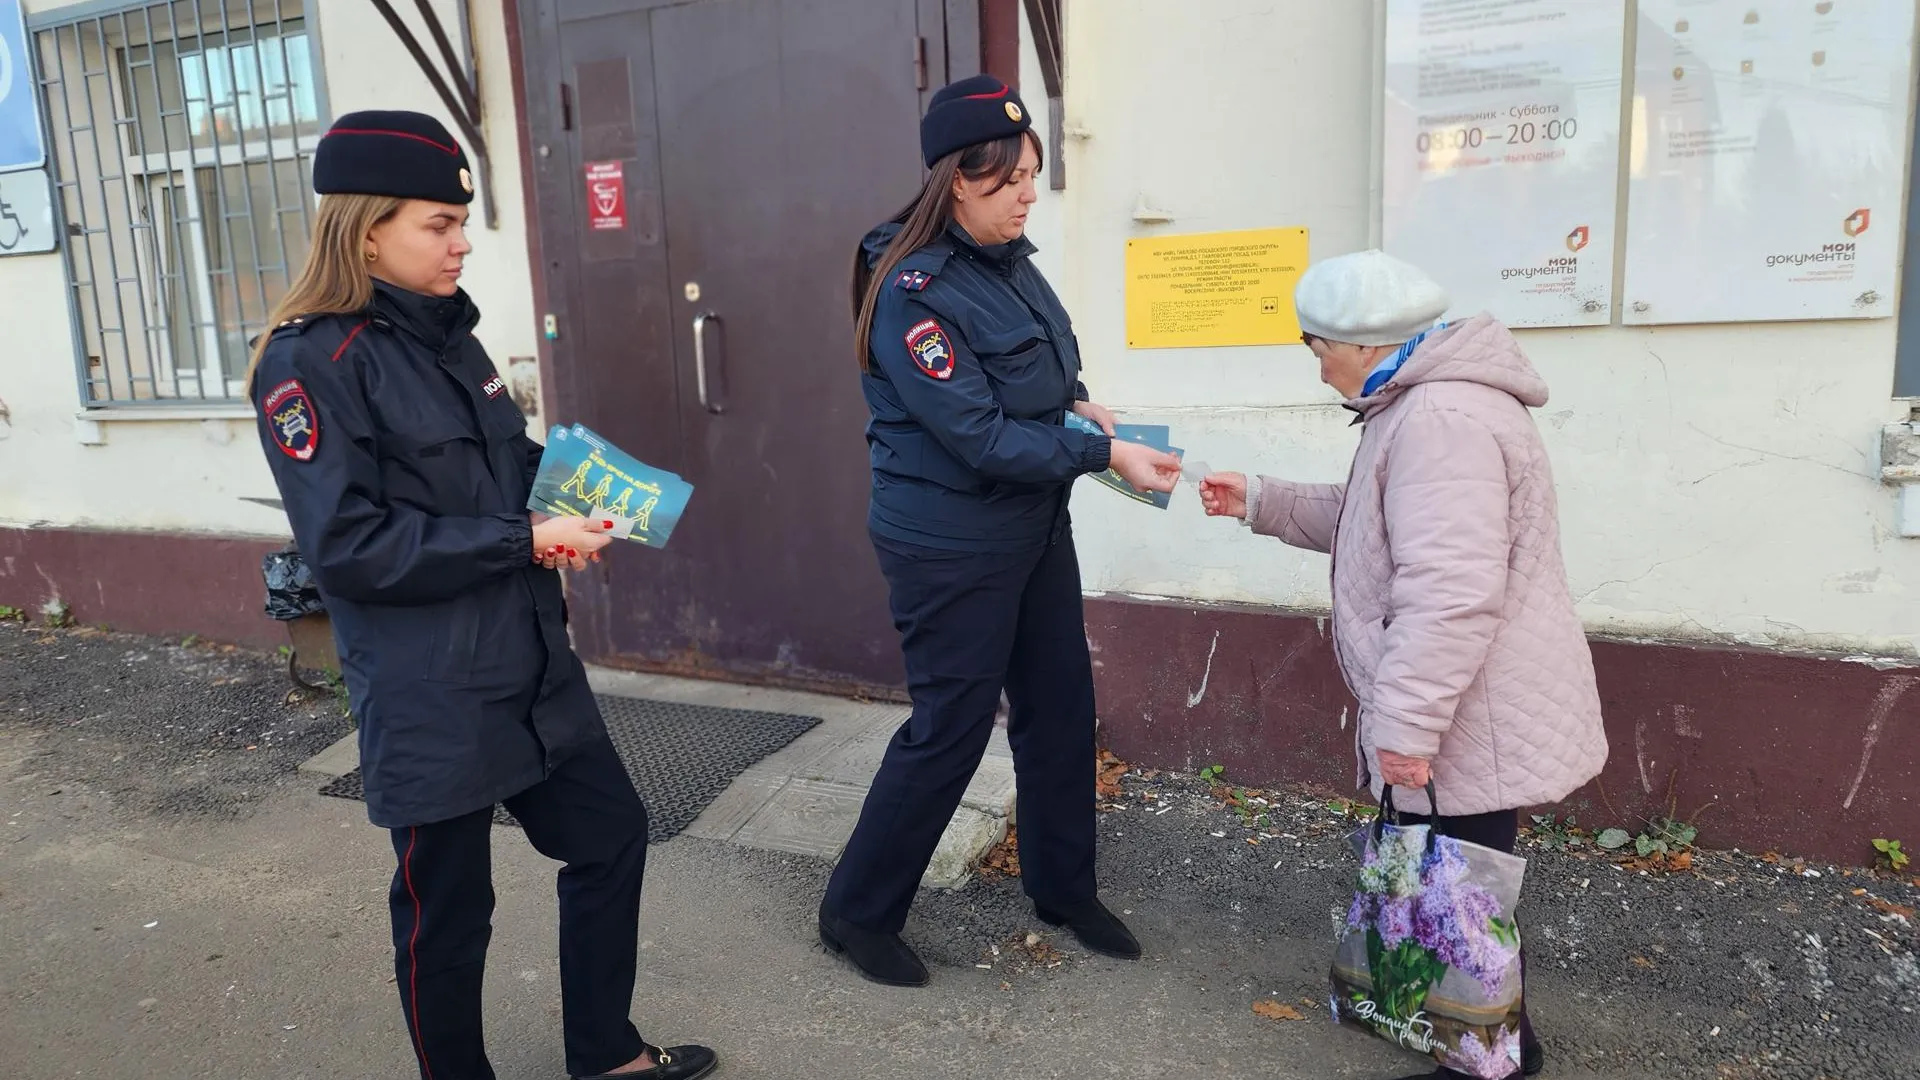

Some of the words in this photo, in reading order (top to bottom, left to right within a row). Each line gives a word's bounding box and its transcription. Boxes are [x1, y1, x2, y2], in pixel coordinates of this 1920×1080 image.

[1509, 104, 1560, 119] Суббота
[1823, 243, 1856, 252] мои
[1549, 257, 1577, 266] мои
[1766, 252, 1855, 267] документы
[1501, 265, 1577, 280] документы
[906, 321, 935, 343] ПОЛИЦИЯ
[937, 366, 953, 379] МВД
[266, 381, 298, 407] ПОЛИЦИЯ
[1355, 1000, 1433, 1043] Bouquet
